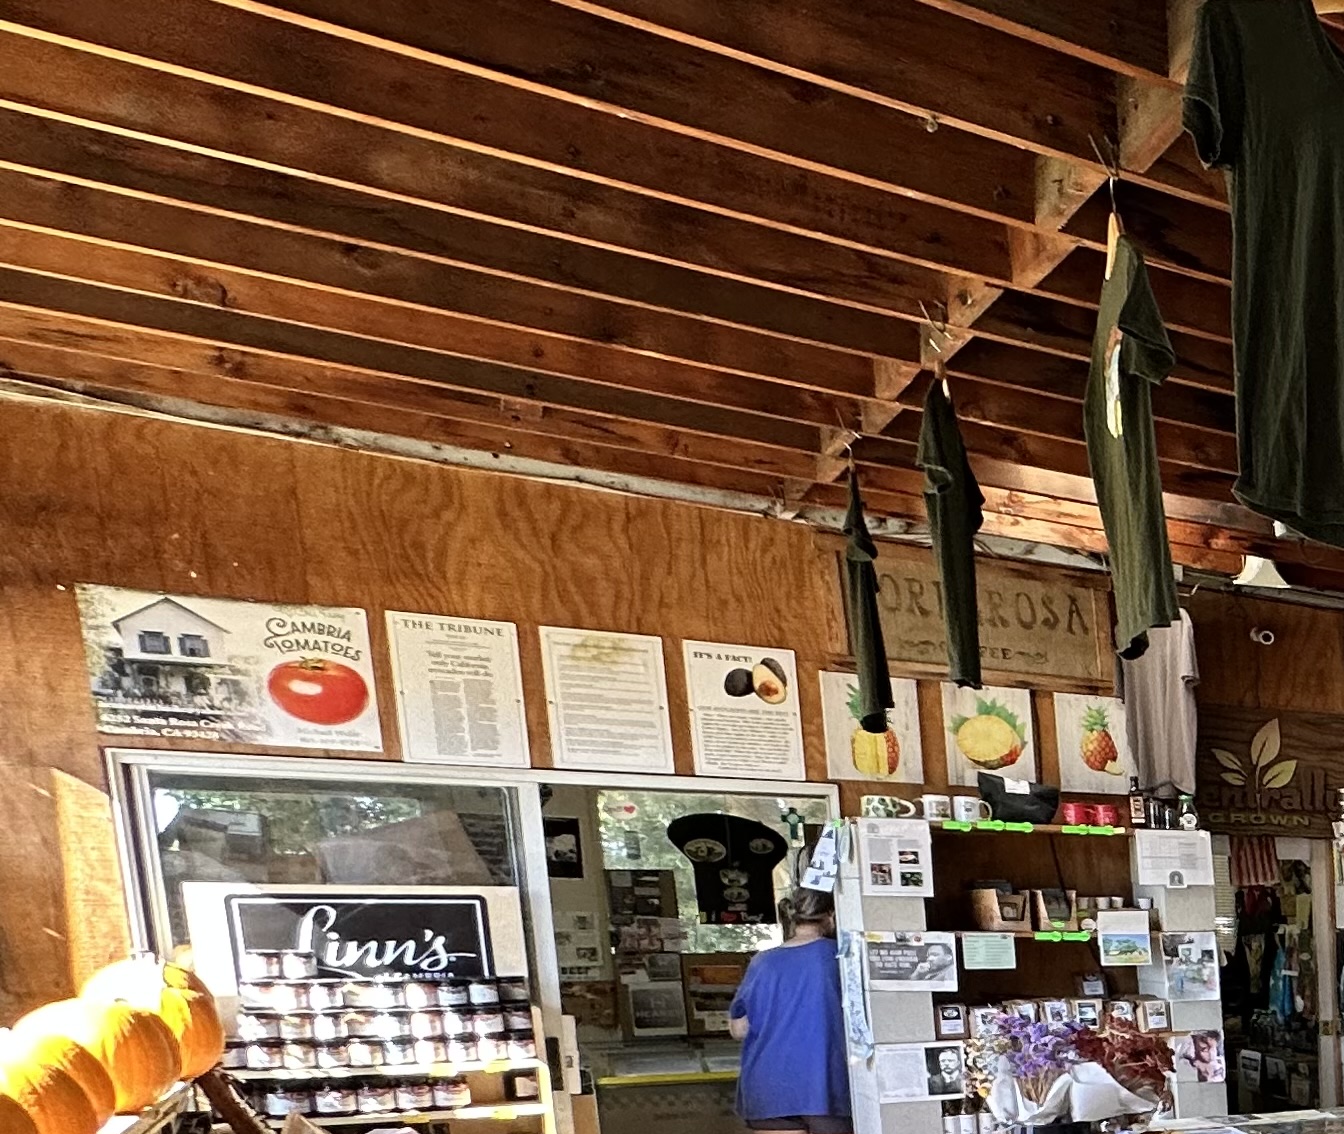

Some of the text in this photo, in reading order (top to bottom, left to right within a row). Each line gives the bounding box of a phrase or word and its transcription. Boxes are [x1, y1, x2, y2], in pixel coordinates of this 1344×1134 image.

[984, 588, 1091, 636] ROSA
[265, 616, 352, 642] CAMBRIA
[400, 618, 505, 638] THE TRIBUNE
[263, 632, 364, 661] TOMATOES
[1208, 812, 1311, 826] GROWN
[297, 904, 477, 975] Linn's
